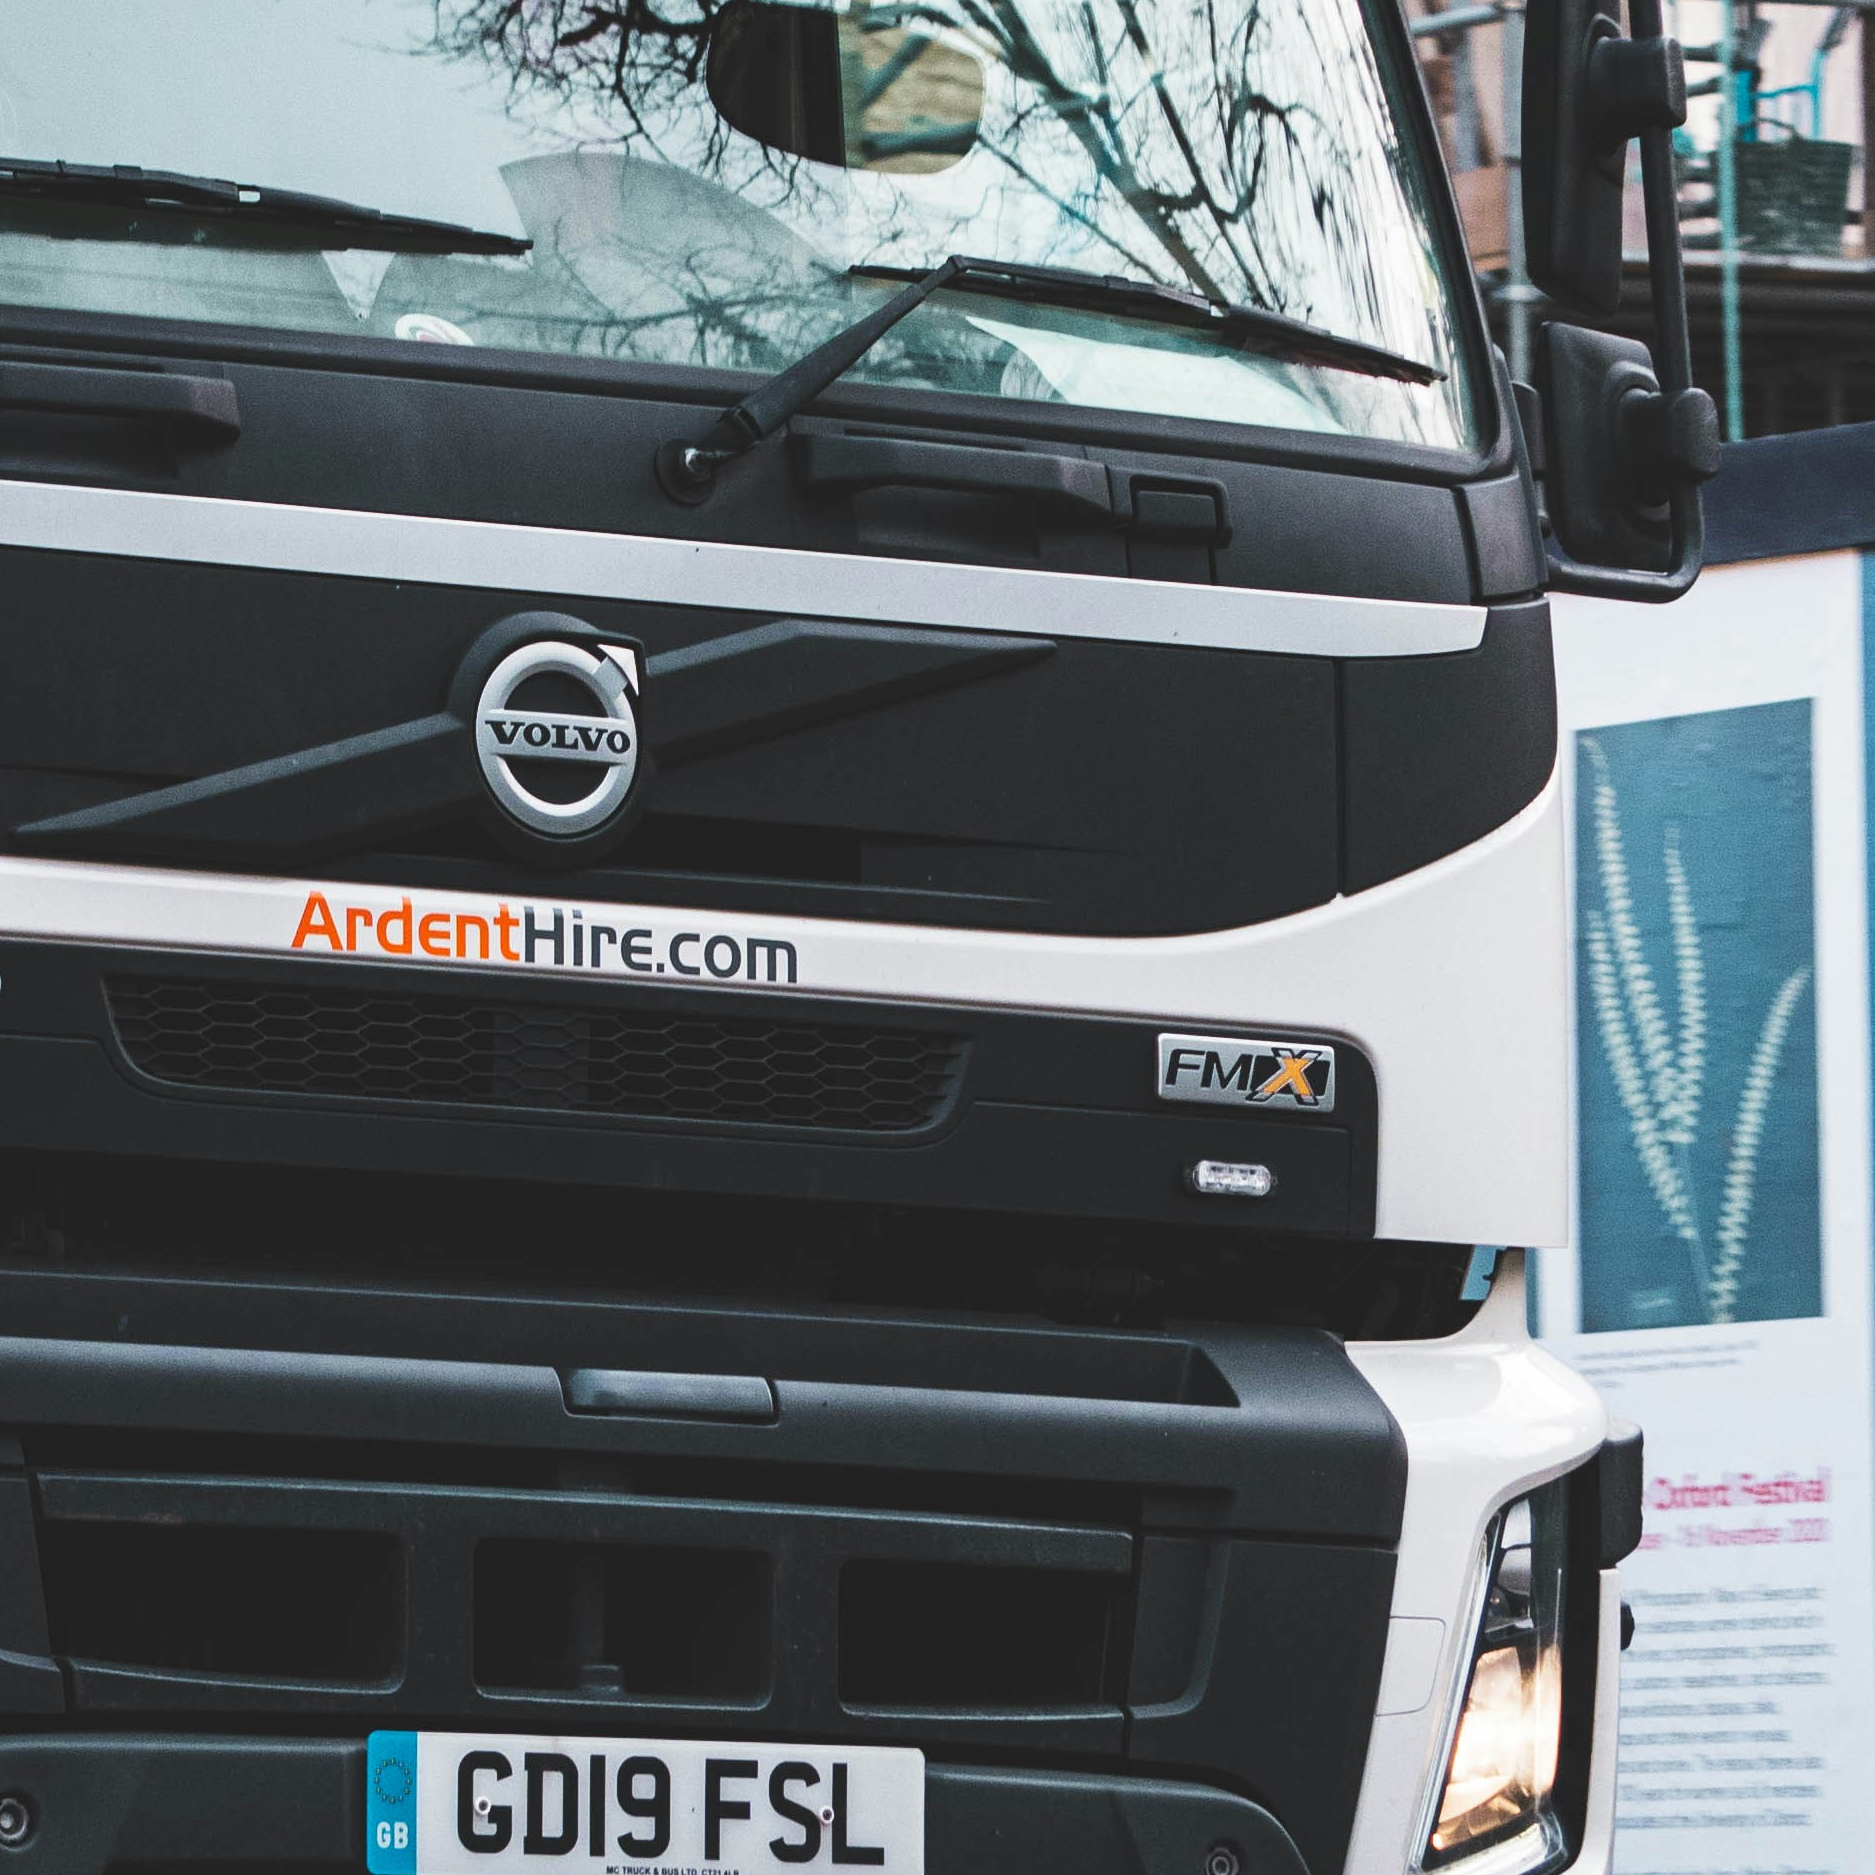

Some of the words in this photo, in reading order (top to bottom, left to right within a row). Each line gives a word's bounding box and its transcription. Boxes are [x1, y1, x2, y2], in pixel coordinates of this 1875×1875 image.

[484, 720, 631, 754] VOLVO
[290, 890, 799, 985] ArdentHire.com
[1164, 1046, 1323, 1107] FMX
[456, 1749, 672, 1858] GD19
[704, 1757, 885, 1867] FSL
[376, 1821, 409, 1849] GB
[606, 1865, 620, 1875] MC
[622, 1866, 651, 1875] TRUCK
[653, 1867, 660, 1875] &
